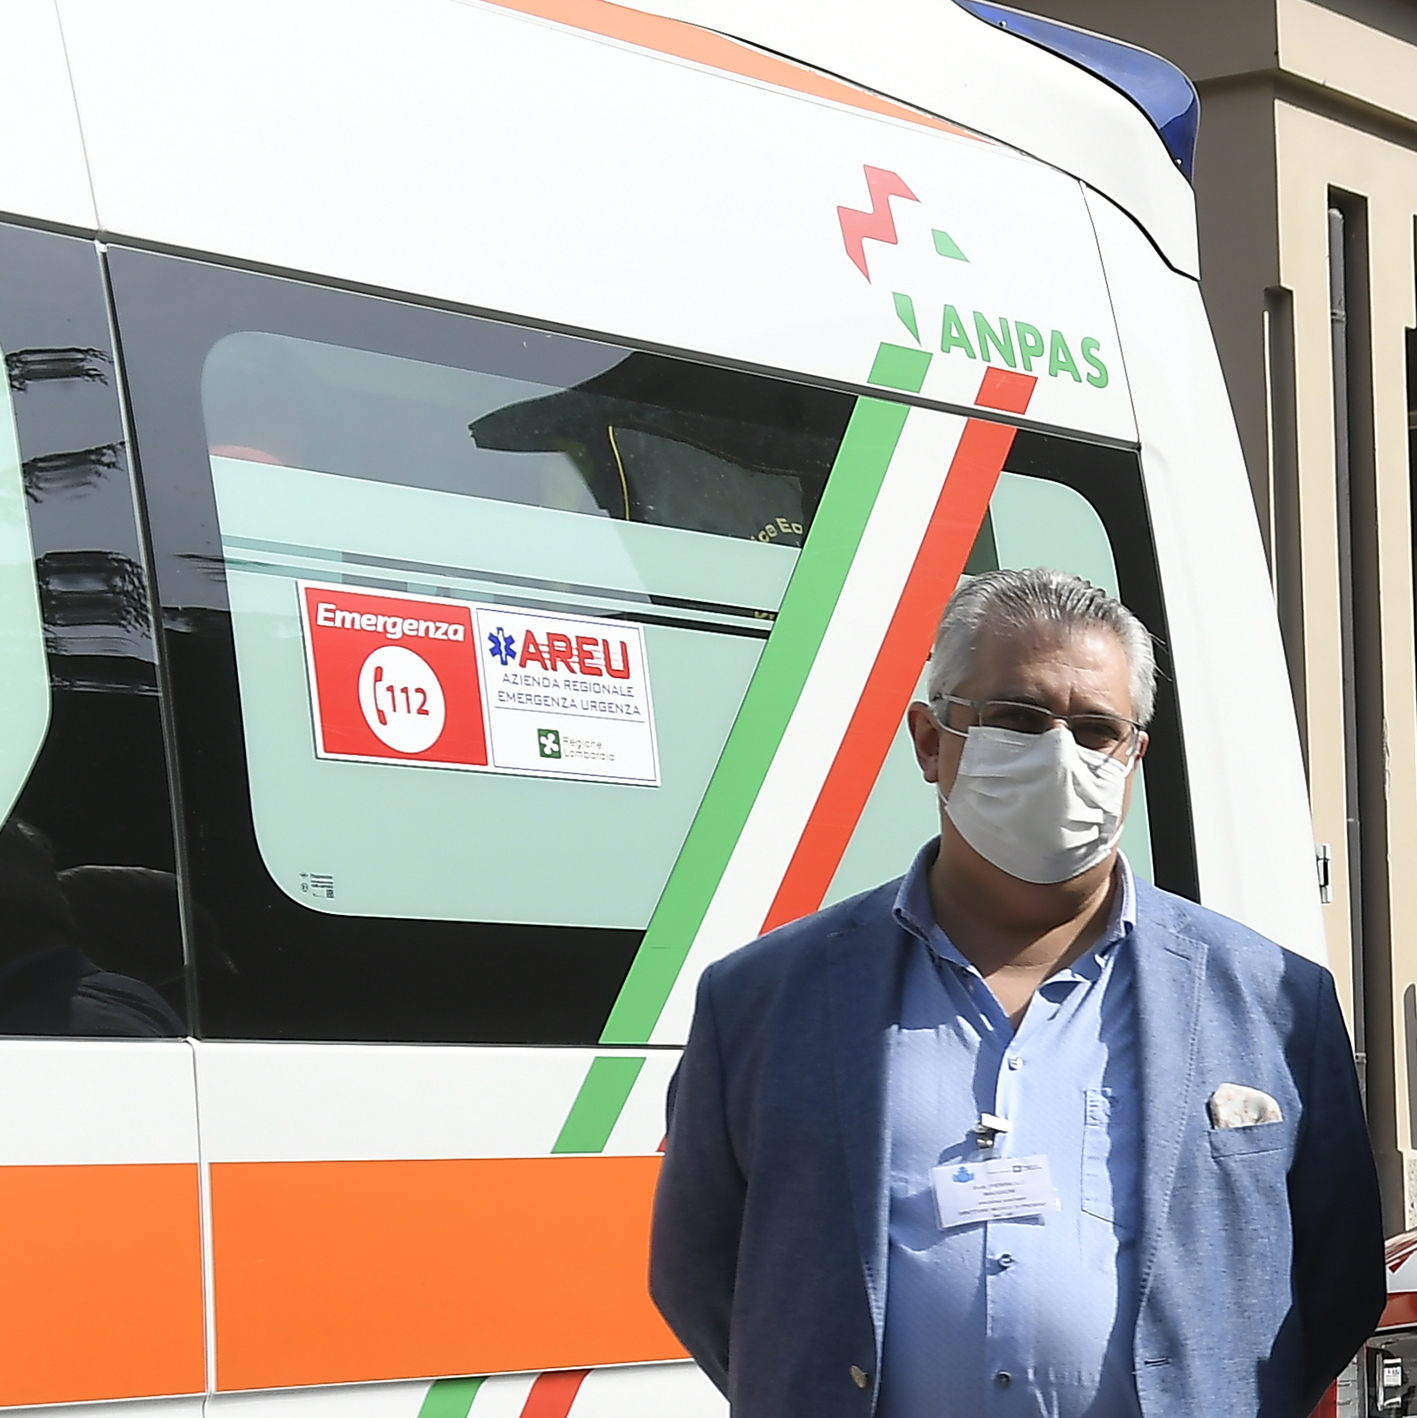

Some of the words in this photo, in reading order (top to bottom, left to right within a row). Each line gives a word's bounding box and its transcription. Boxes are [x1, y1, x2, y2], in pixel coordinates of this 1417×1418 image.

[940, 304, 1109, 389] ANPAS
[316, 602, 465, 642] Emergenza
[518, 630, 630, 680] AREU
[386, 685, 430, 716] 112
[502, 673, 560, 690] AZIENDA
[563, 679, 635, 698] REGIONALE
[498, 690, 578, 709] EMERGENZA
[581, 700, 641, 716] URGENZA
[562, 736, 603, 751] Regione
